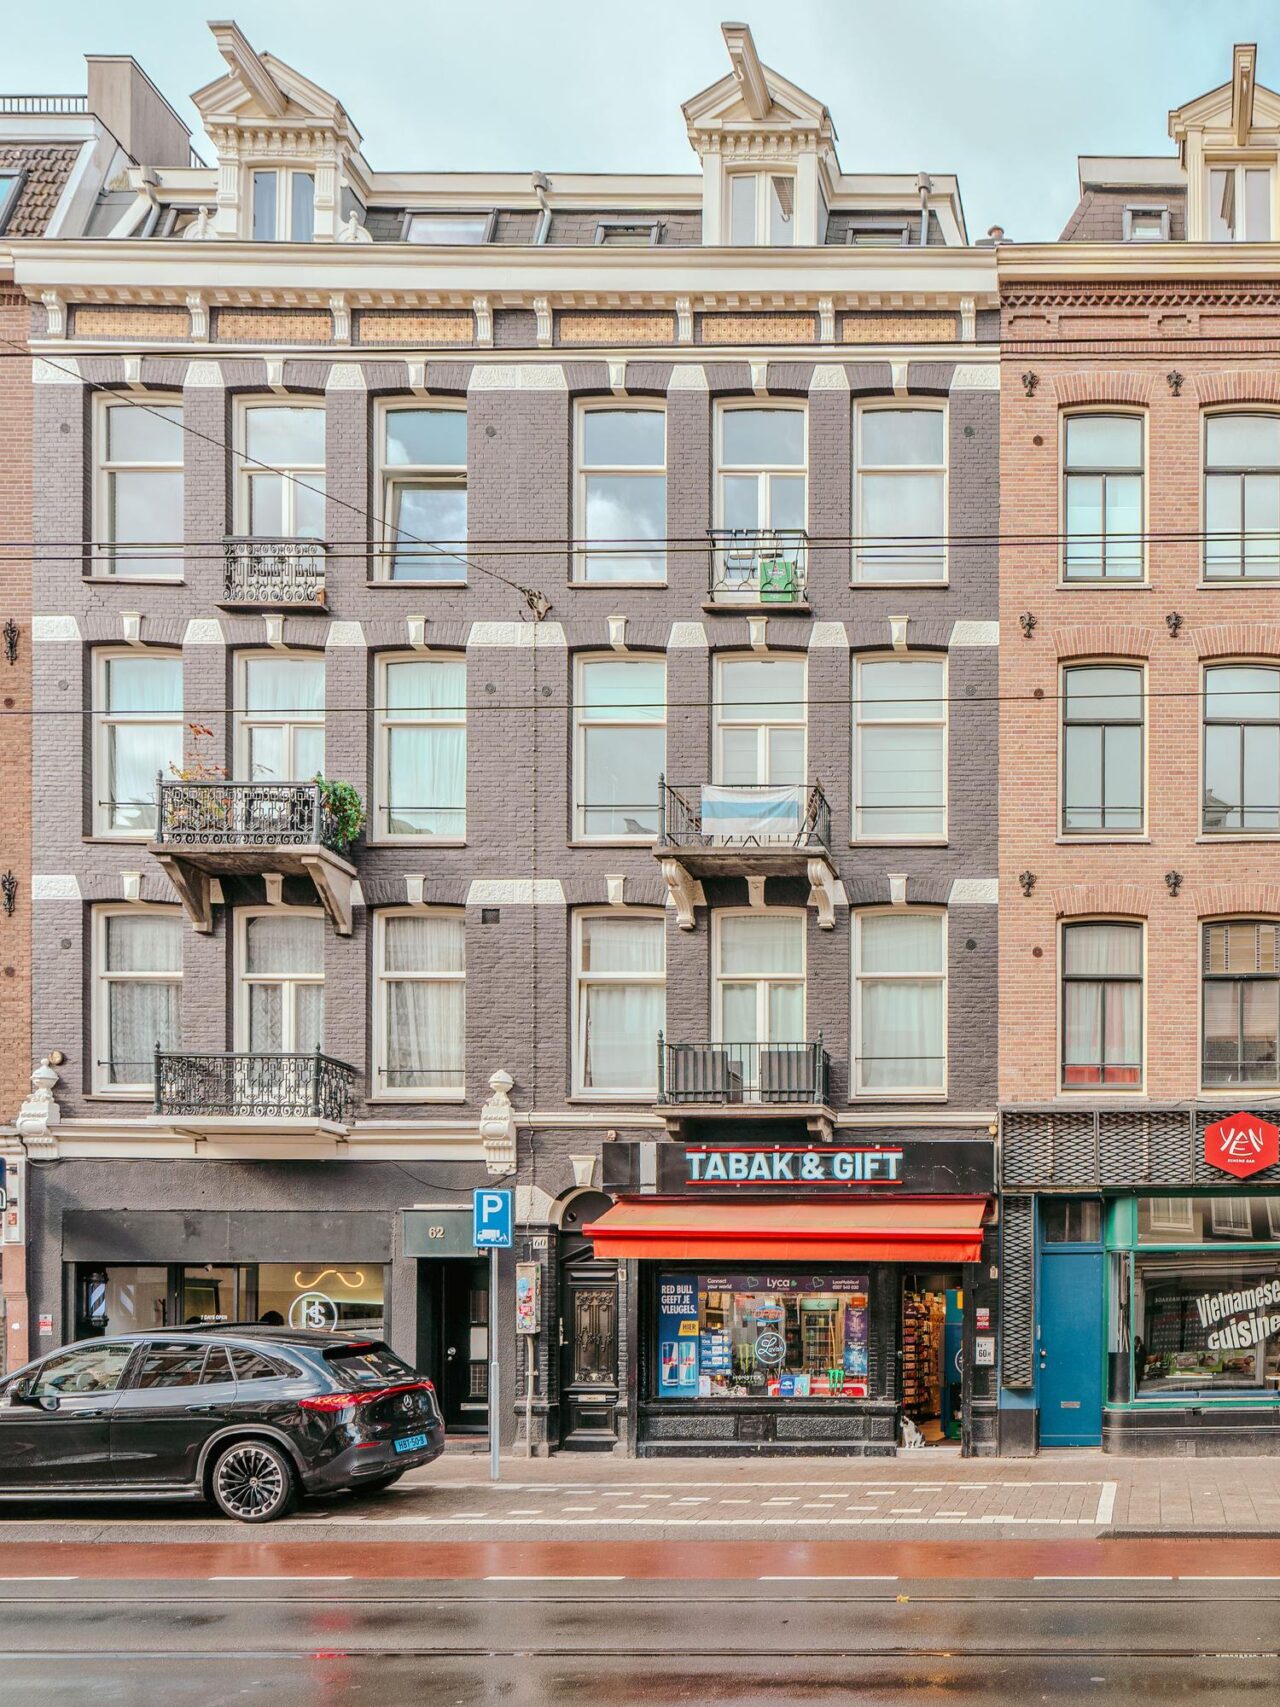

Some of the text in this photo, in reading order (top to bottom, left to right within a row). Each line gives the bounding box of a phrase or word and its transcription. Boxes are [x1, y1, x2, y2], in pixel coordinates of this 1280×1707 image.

[686, 1152, 903, 1180] TABAK & GIFT
[482, 1194, 503, 1223] P
[428, 1226, 445, 1238] 62
[534, 1239, 547, 1247] 60
[766, 1277, 790, 1288] Lyca
[661, 1285, 693, 1294] RED BULL
[661, 1295, 690, 1304] GEEFT JE
[1196, 1279, 1280, 1328] Vietnamese
[661, 1305, 697, 1314] VLEUGELS.
[682, 1323, 696, 1331] HIER
